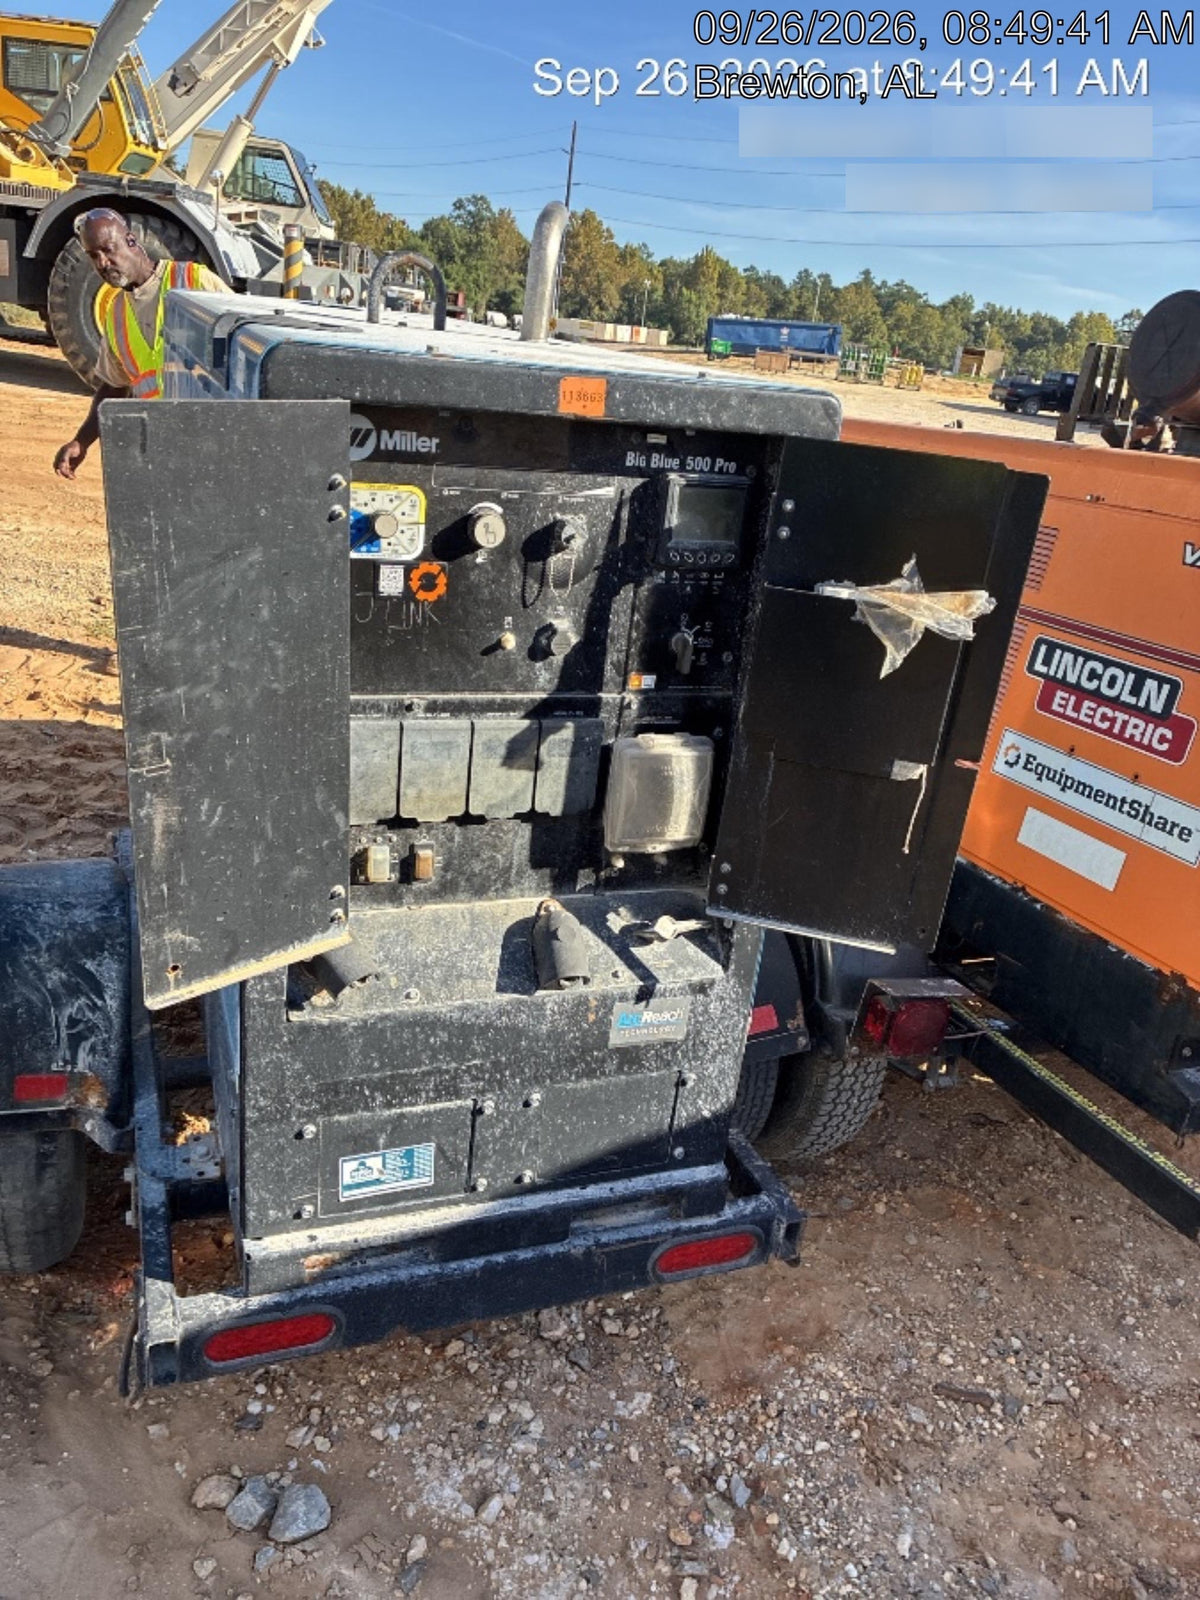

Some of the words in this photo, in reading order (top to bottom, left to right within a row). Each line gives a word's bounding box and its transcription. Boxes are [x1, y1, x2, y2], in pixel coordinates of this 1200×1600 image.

[380, 429, 440, 453] Miller
[625, 451, 647, 467] Big
[650, 453, 680, 469] Blue
[685, 456, 711, 472] 500
[714, 457, 737, 474] Pro
[1034, 644, 1170, 714] LINCOLN
[1051, 689, 1173, 751] ELECTRIC
[1022, 753, 1193, 843] EquipmentShare
